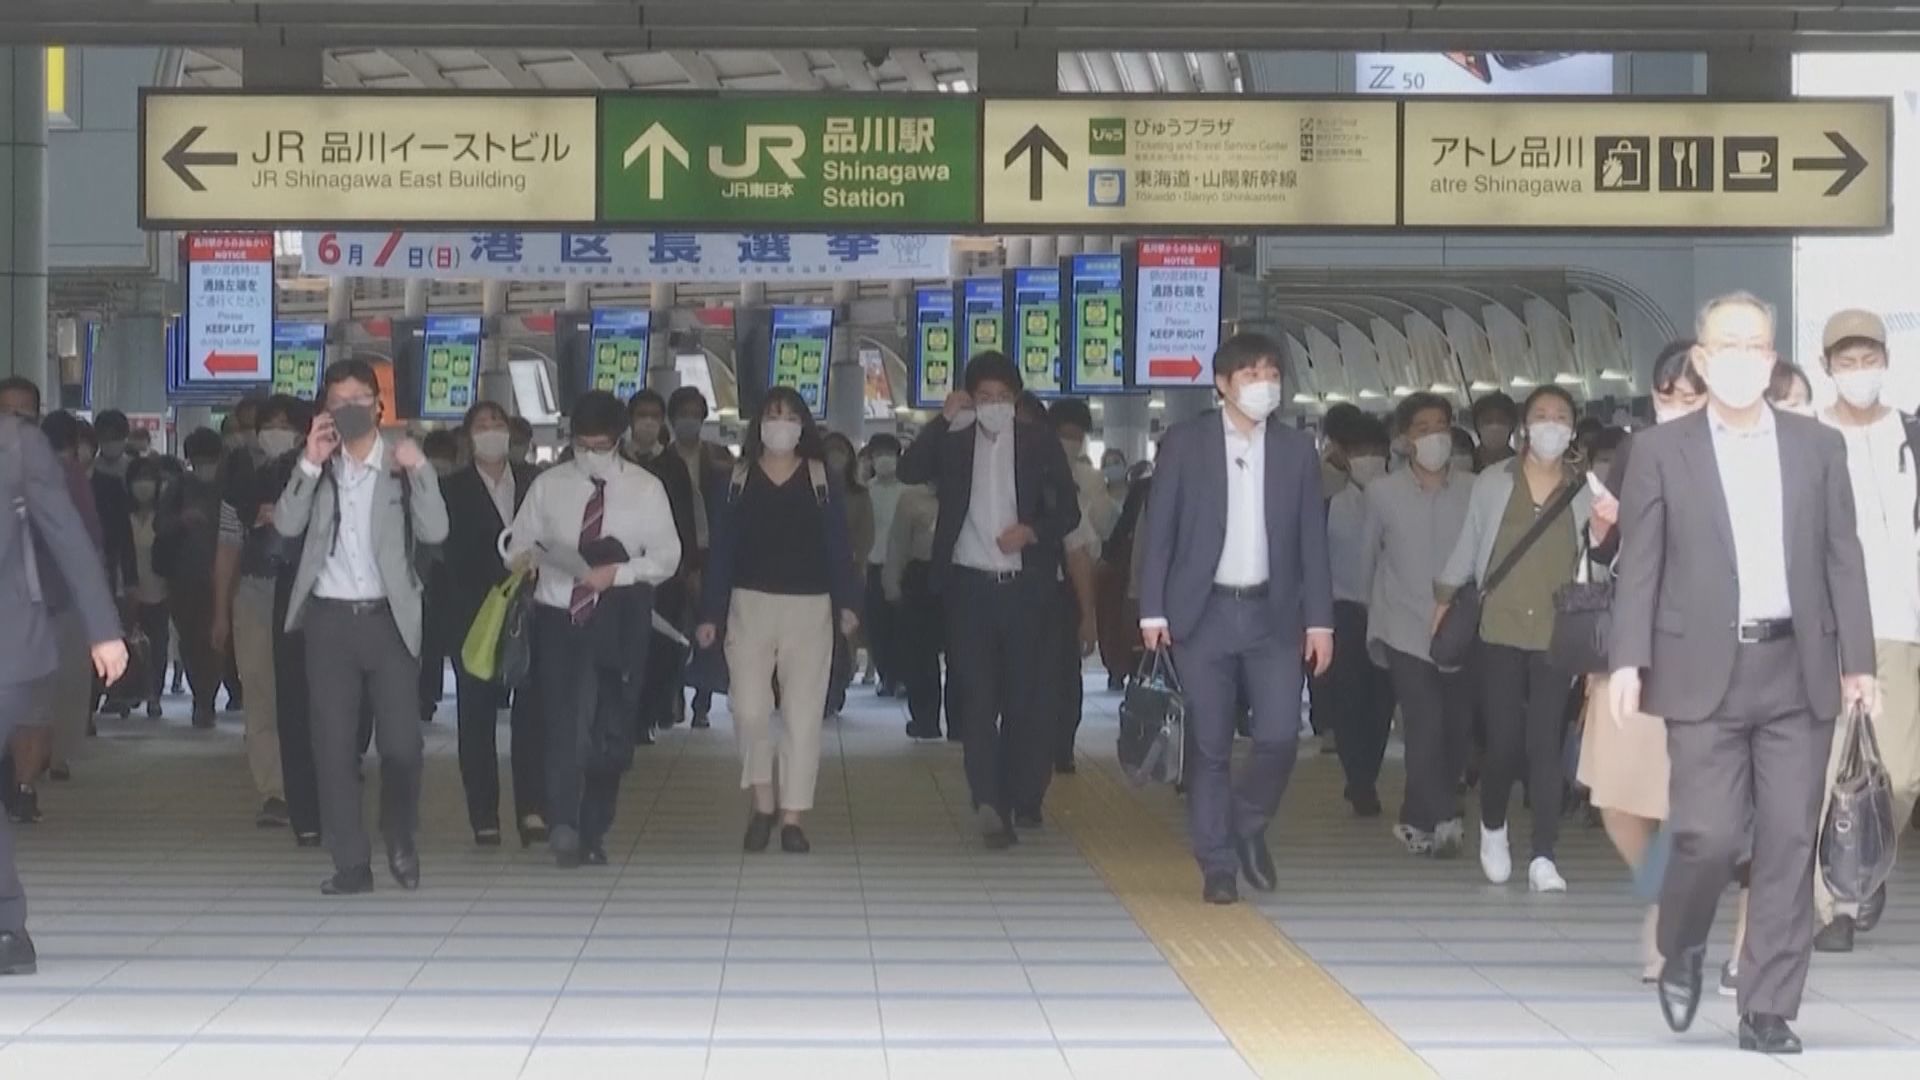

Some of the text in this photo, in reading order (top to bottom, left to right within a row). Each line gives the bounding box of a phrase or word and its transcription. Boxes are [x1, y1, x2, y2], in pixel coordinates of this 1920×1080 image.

[1402, 73, 1425, 89] 50
[823, 117, 936, 154] 品川駅
[1134, 118, 1236, 136] びゅうプラザ
[252, 131, 571, 164] JR 品川イーストビル
[708, 124, 806, 179] JR
[1430, 136, 1584, 169] アトレ品川
[252, 170, 527, 192] JR Shinagawa East Building
[823, 160, 950, 185] Shinagawa
[721, 182, 795, 199] JR東日本
[1430, 174, 1583, 197] atre Shinagawa
[823, 188, 905, 208] Station
[214, 250, 247, 260] NOTICE
[1163, 256, 1196, 266] NOTICE
[205, 324, 256, 334] KEEP LEFT
[1149, 329, 1206, 339] KEEP RIGHT
